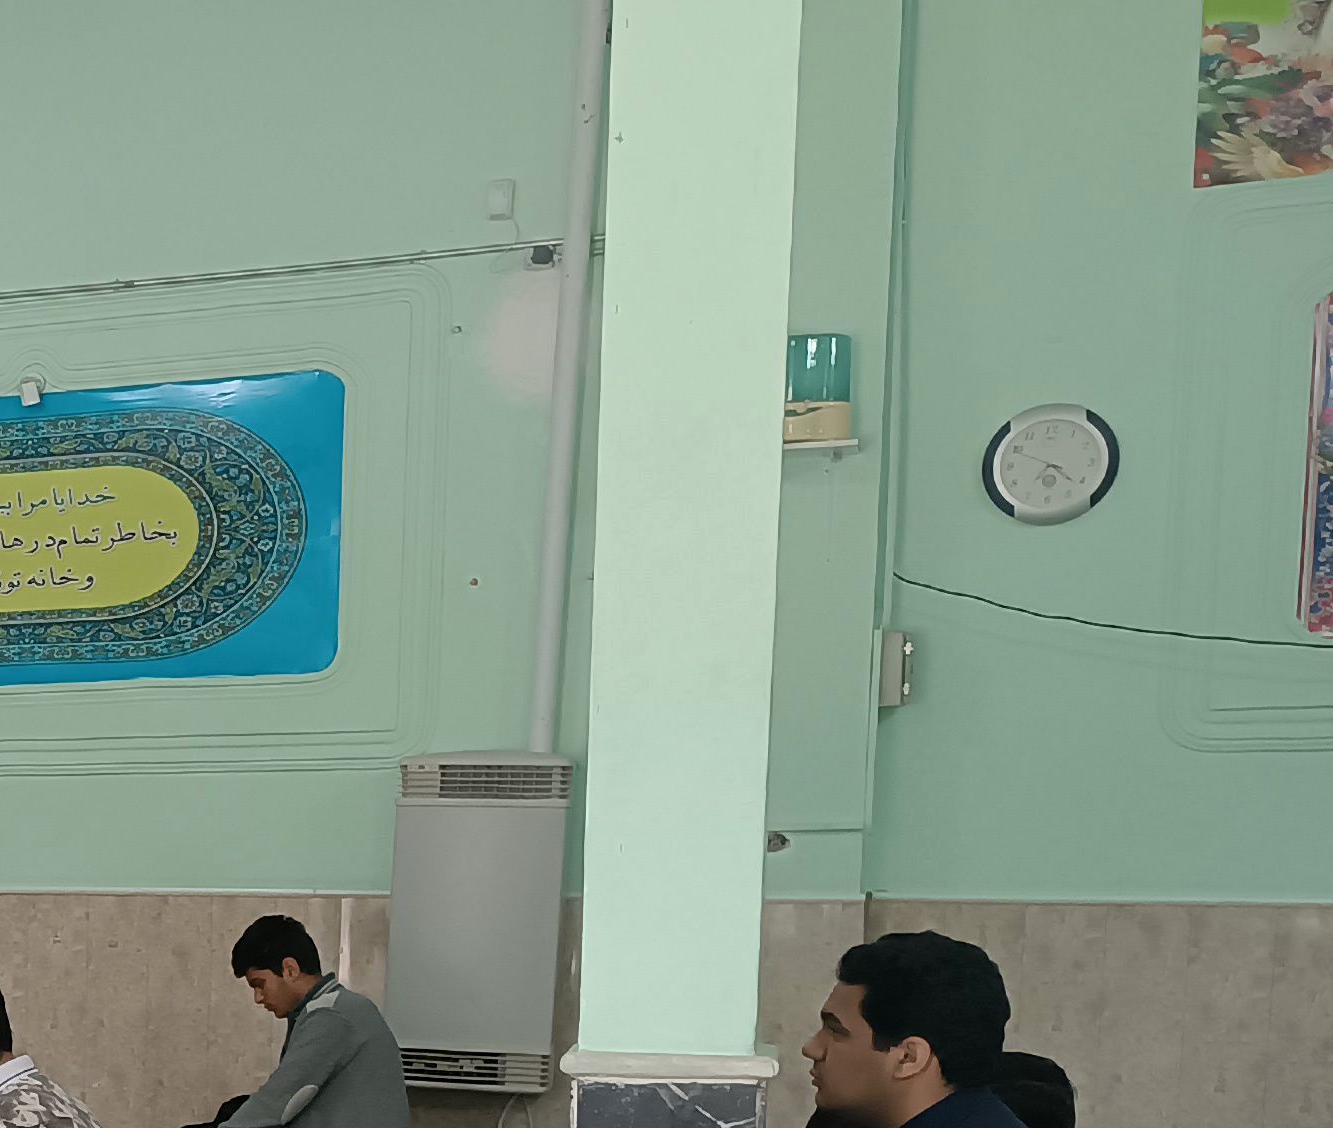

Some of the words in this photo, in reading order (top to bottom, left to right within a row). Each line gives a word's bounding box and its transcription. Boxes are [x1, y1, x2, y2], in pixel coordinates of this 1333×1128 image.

[18, 491, 47, 516] مرا
[52, 486, 116, 512] خدایا
[56, 525, 100, 558] تمام
